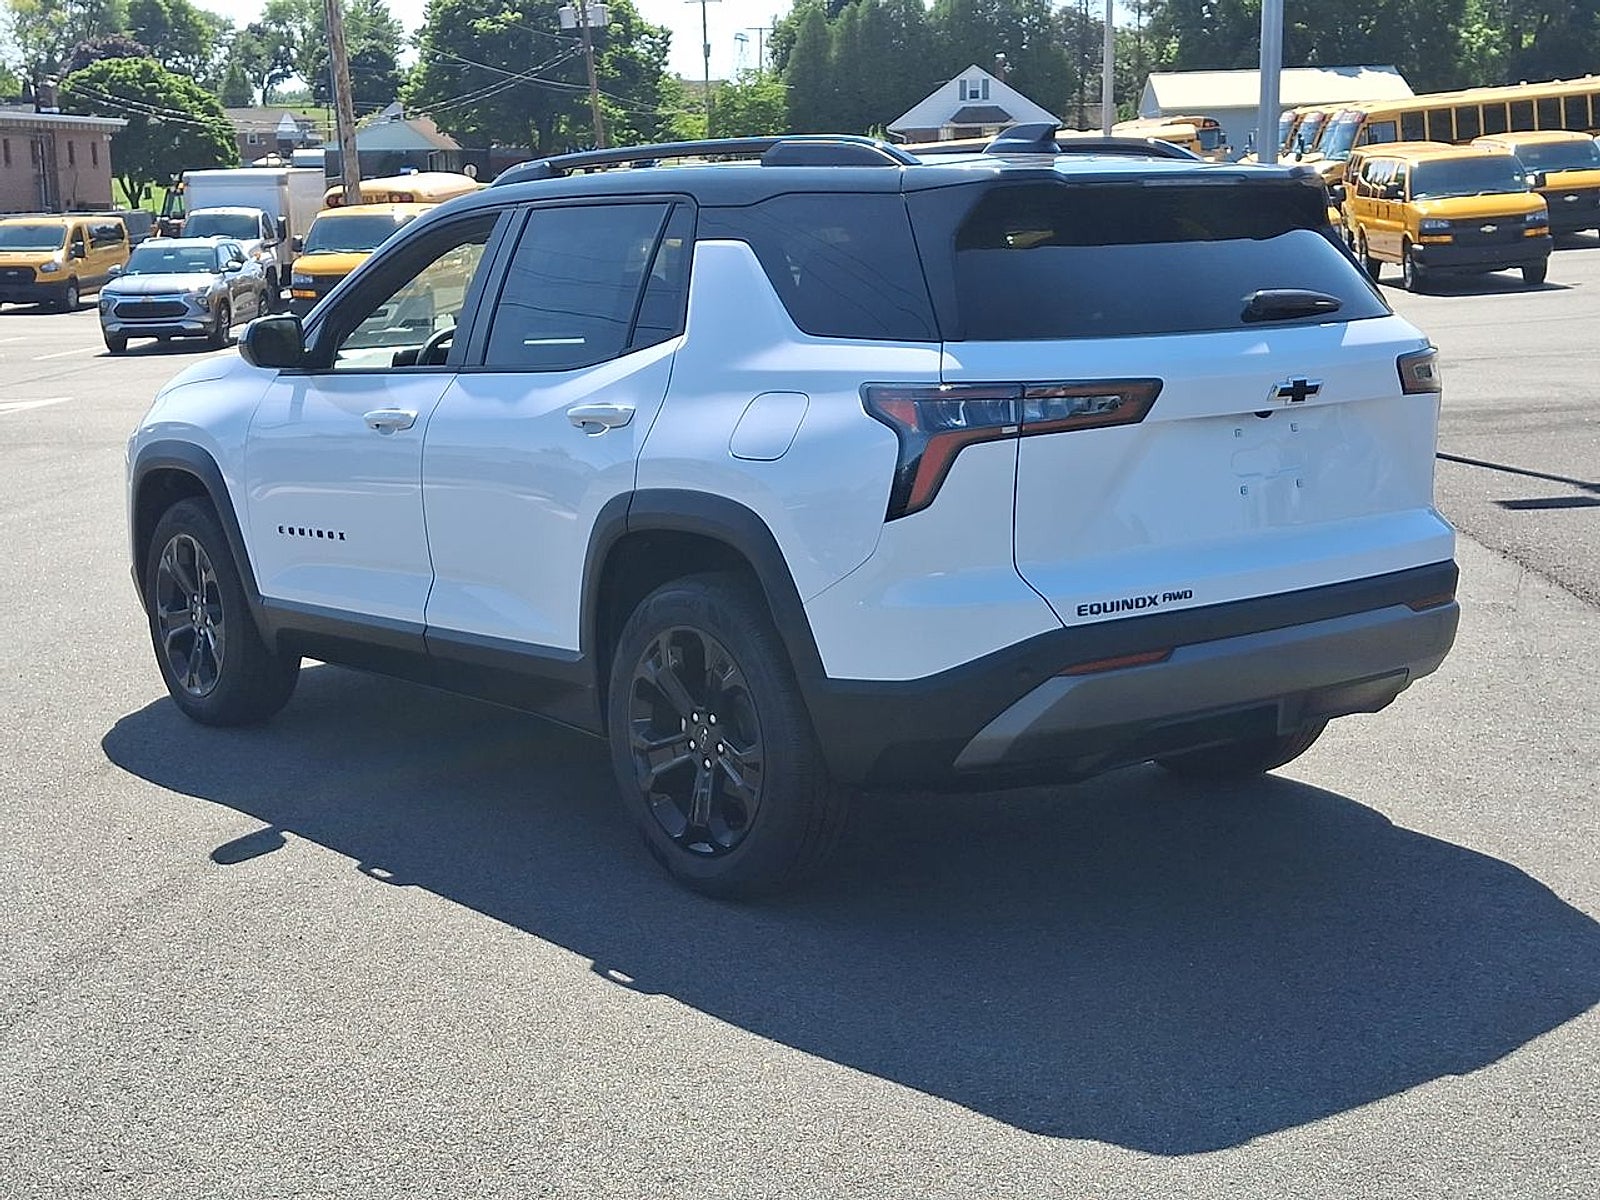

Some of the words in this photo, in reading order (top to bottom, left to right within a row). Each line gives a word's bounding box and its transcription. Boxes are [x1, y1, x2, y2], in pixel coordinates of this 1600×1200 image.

[278, 525, 346, 541] EQUINOX
[1077, 594, 1158, 616] EQUINOX
[1162, 589, 1193, 603] AWD
